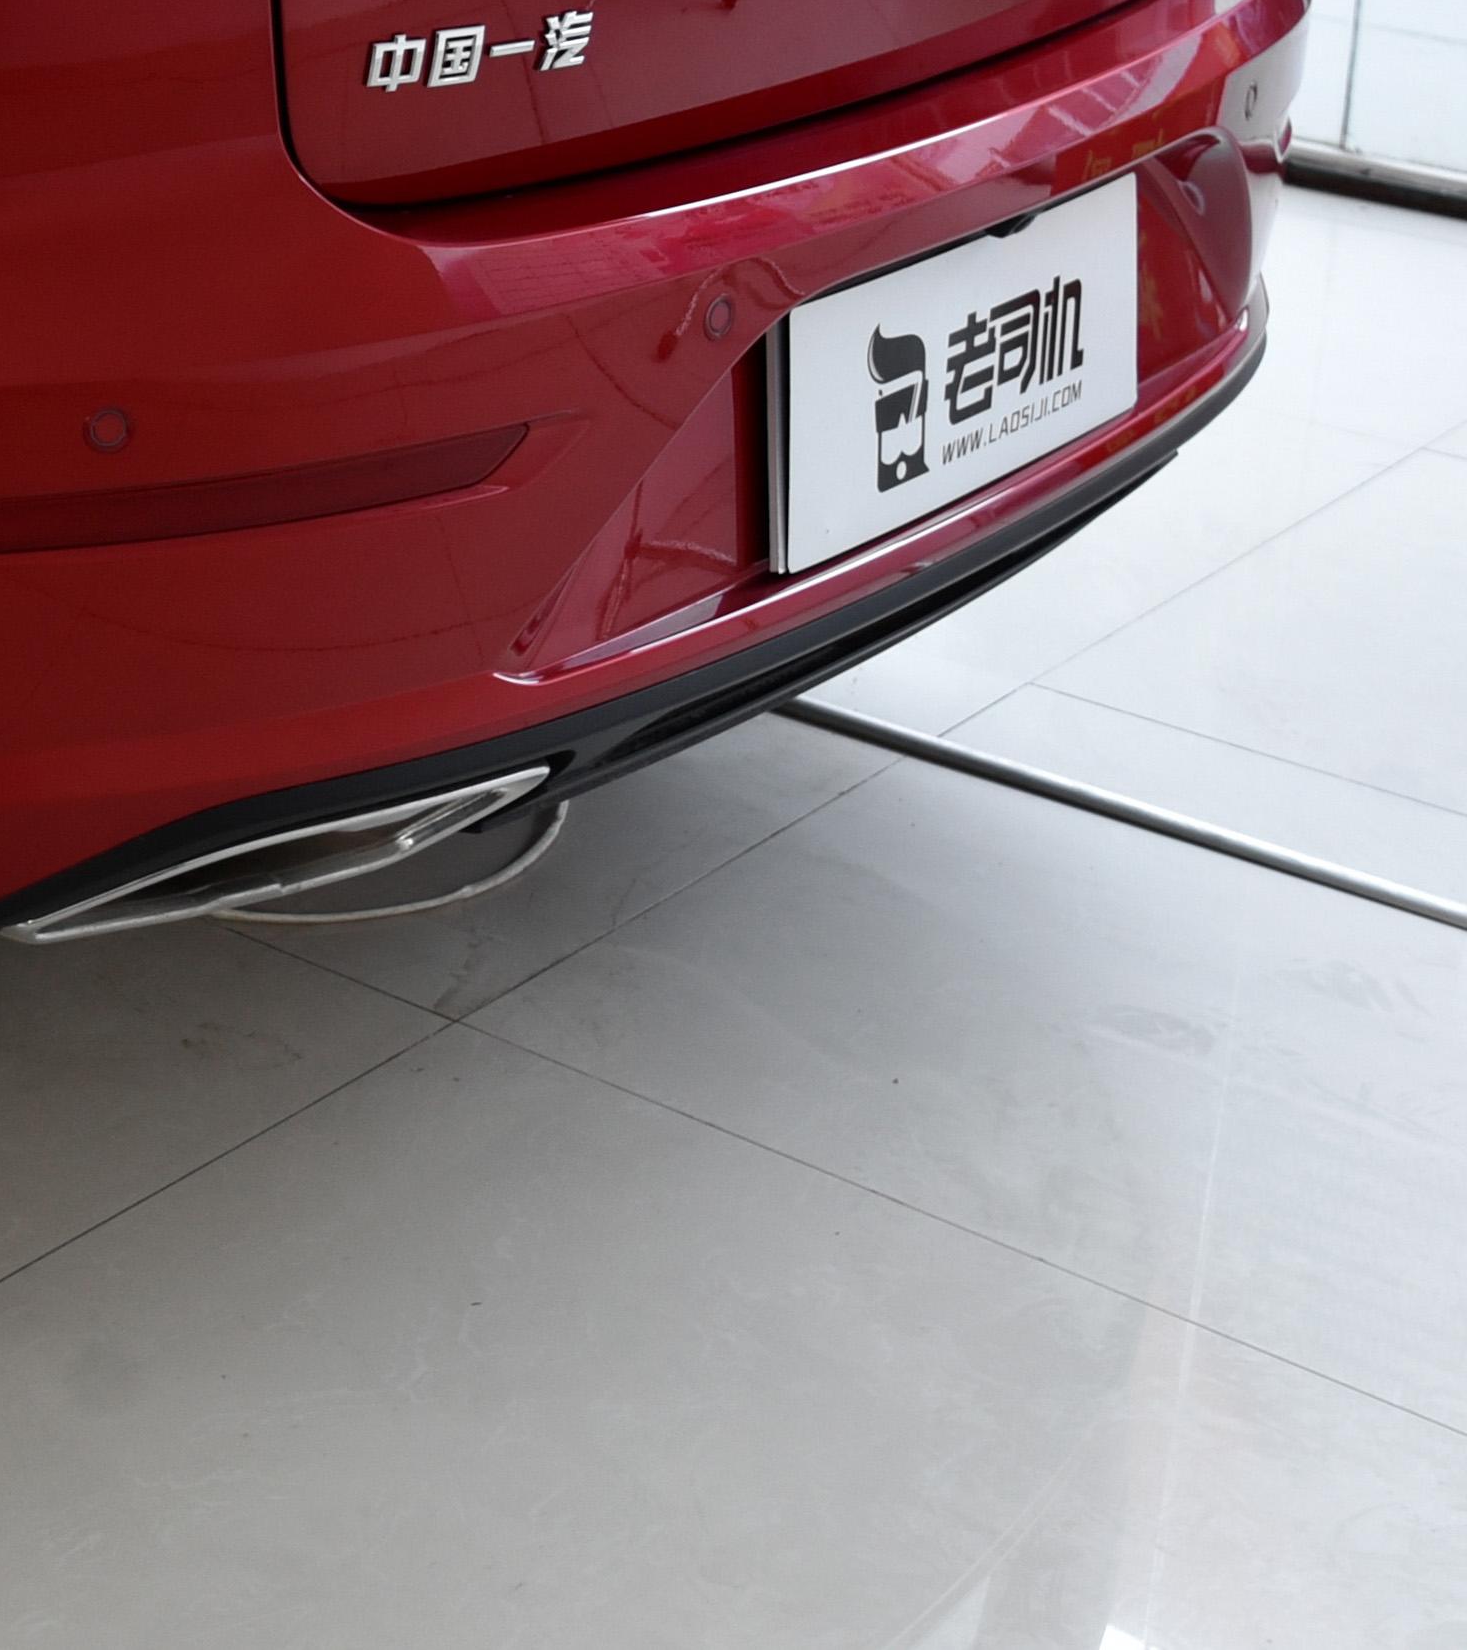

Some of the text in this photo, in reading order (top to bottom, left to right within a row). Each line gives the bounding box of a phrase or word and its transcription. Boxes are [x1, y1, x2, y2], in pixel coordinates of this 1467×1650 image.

[366, 9, 594, 93] 中国一汽
[944, 275, 1085, 426] 老司机
[941, 379, 1083, 467] WWW.LAOSIJI.COM
